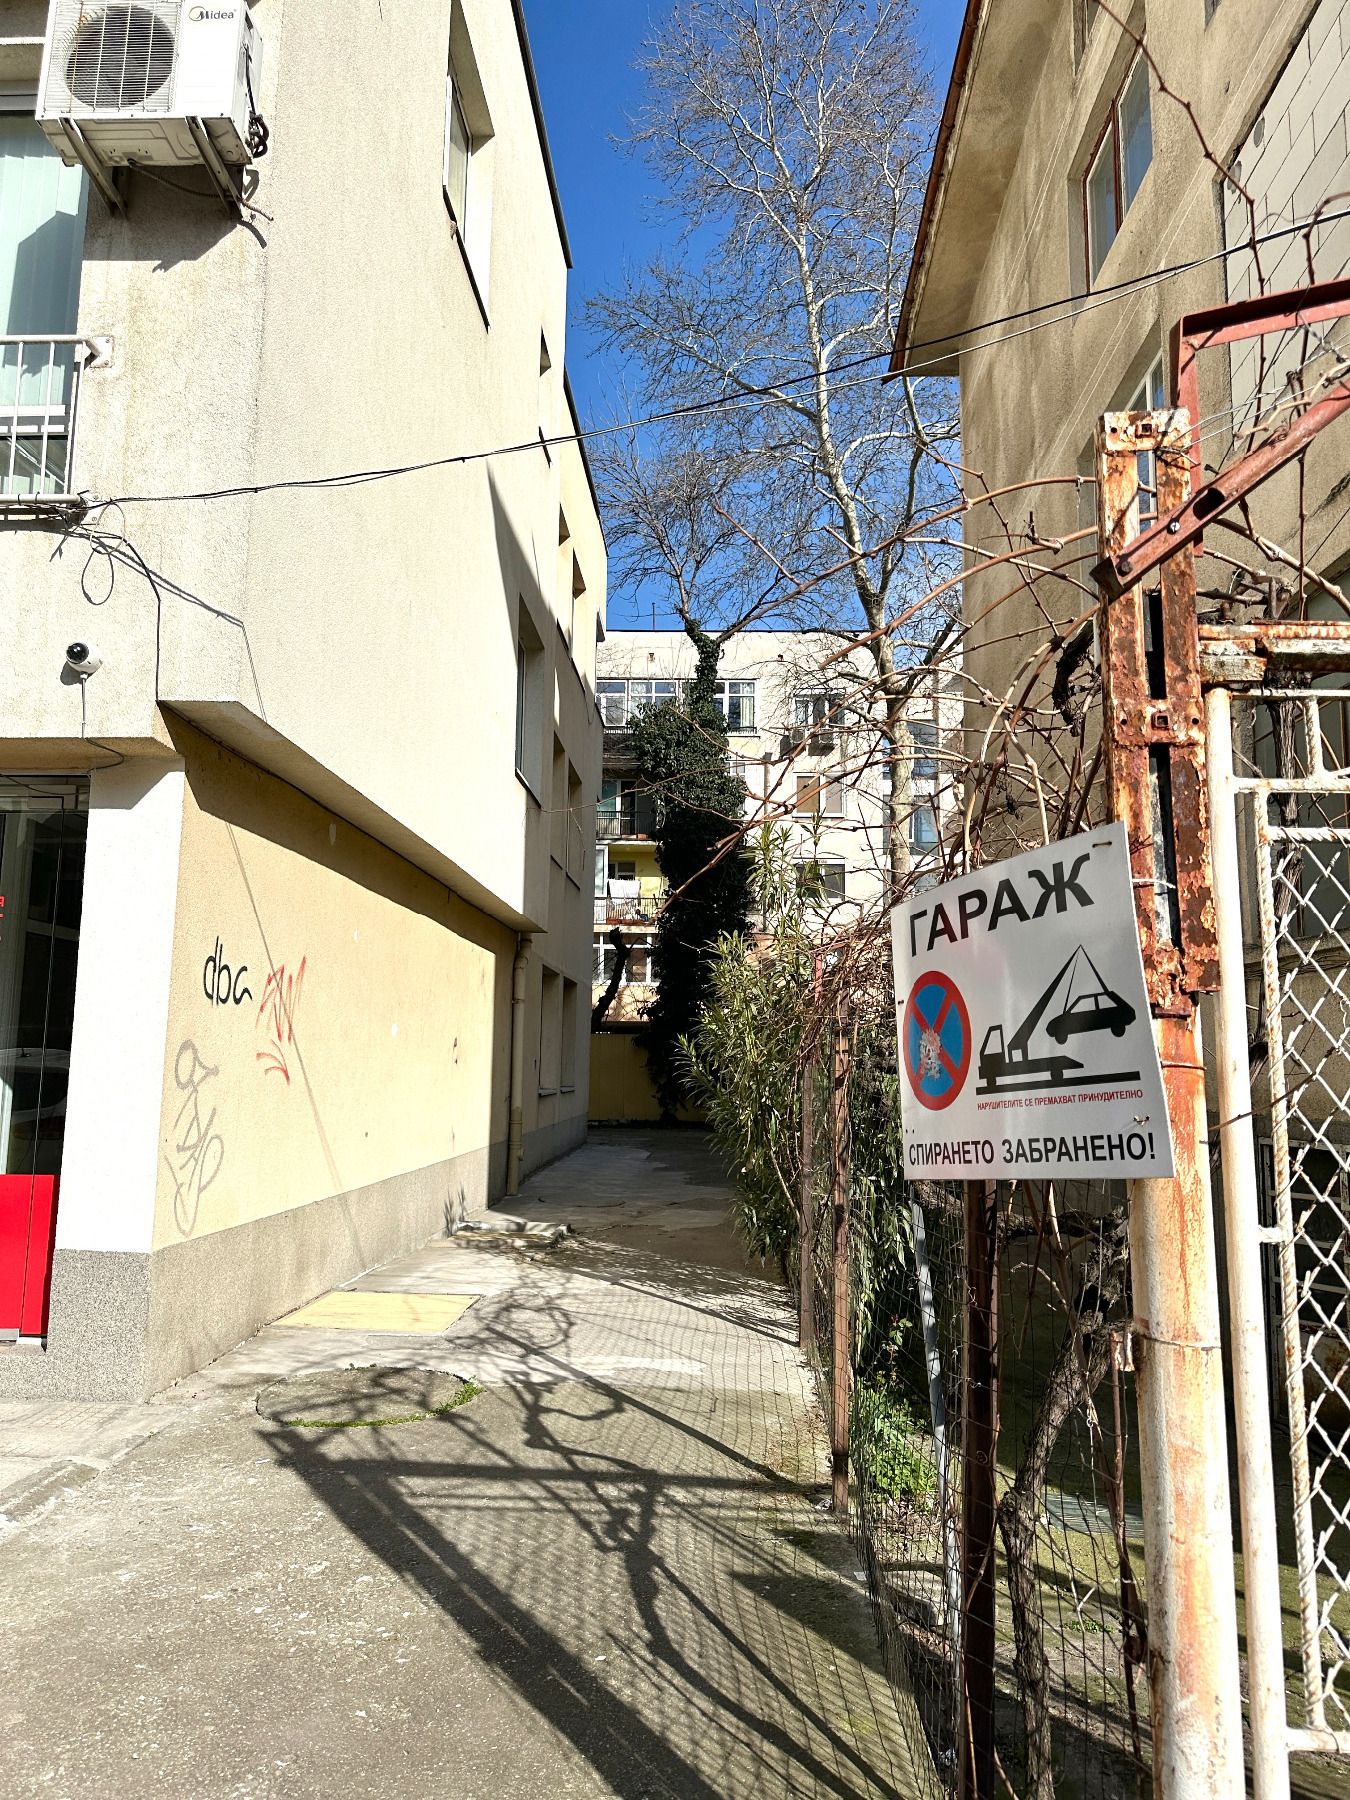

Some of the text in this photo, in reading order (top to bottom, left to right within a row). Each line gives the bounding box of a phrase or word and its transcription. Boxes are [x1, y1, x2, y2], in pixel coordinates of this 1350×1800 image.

[191, 8, 234, 20] Midea
[909, 852, 1095, 957] ГАРАЖ
[977, 1089, 1143, 1110] НАРУШИТЕЛИТЕ СЕ ПРЕМАХВАТ ПРИНУДИТЕЛНО
[909, 1132, 1156, 1166] СПИРАНЕТО ЗАБРАНЕНО!
